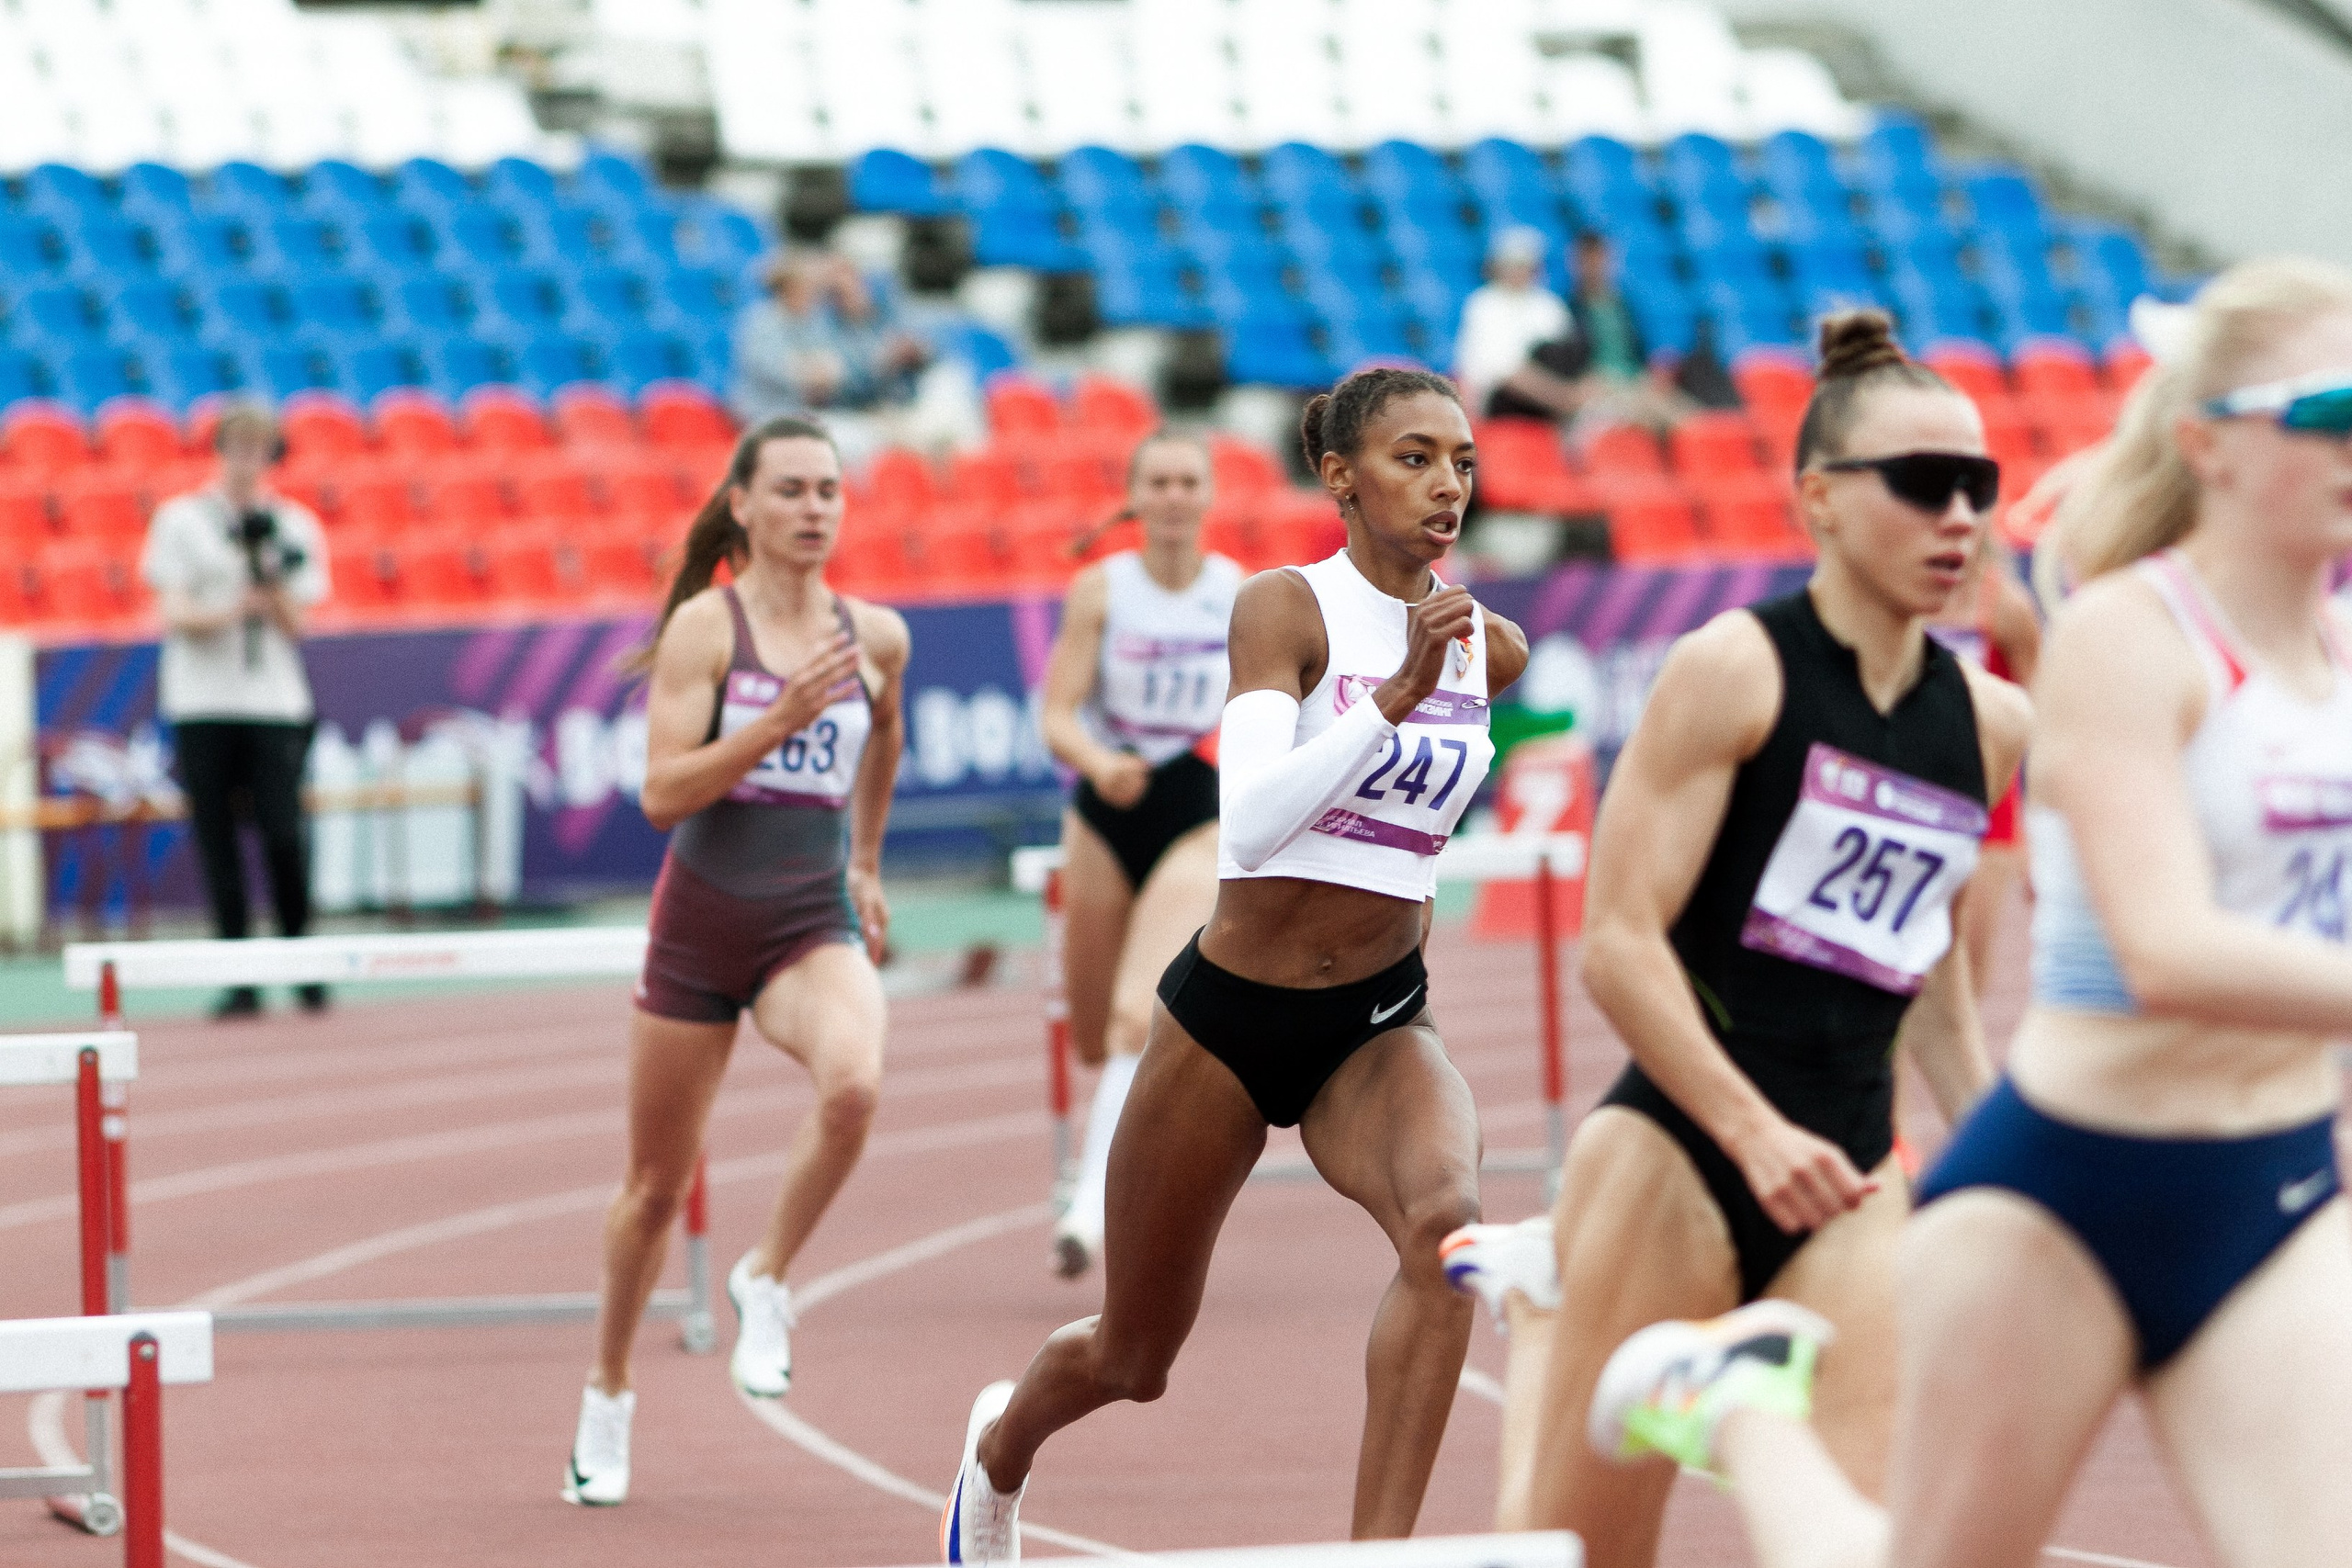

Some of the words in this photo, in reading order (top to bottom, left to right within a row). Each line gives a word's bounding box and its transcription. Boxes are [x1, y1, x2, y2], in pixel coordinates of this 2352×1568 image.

[756, 719, 839, 774] 63
[1354, 732, 1467, 811] 247
[1808, 826, 1947, 933] 257
